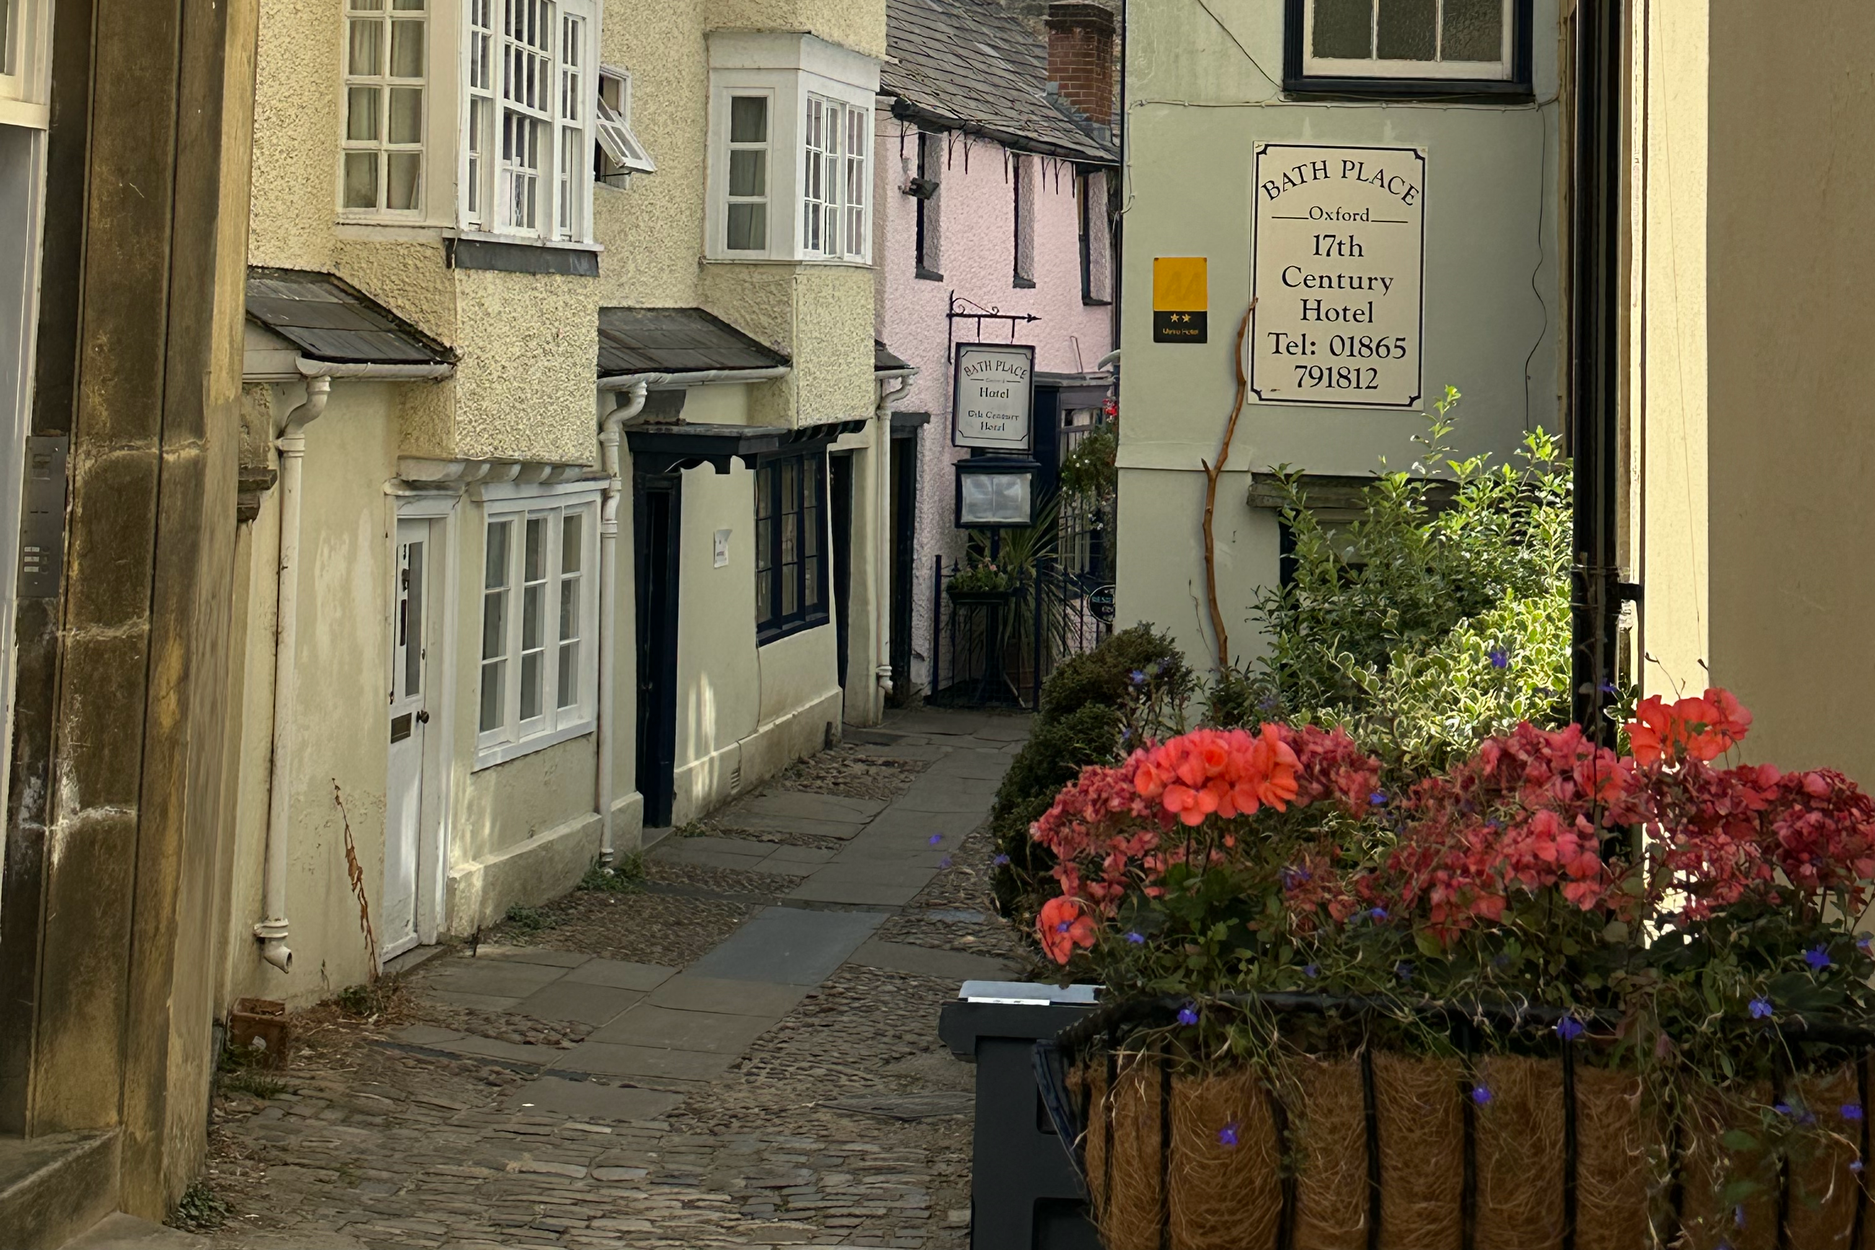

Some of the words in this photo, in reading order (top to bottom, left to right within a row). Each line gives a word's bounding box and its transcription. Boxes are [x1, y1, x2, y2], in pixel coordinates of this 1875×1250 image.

[1261, 160, 1331, 201] BATH
[1340, 159, 1420, 207] PLACE
[1309, 205, 1370, 223] Oxford
[1313, 234, 1365, 258] 17th
[1281, 265, 1394, 296] Century
[1300, 298, 1374, 324] Hotel
[1267, 332, 1317, 356] Tel:
[1329, 334, 1407, 360] 01865
[963, 360, 992, 377] BATH
[995, 359, 1028, 379] PLACE
[1294, 365, 1379, 390] 791812
[979, 386, 1009, 399] Hotel
